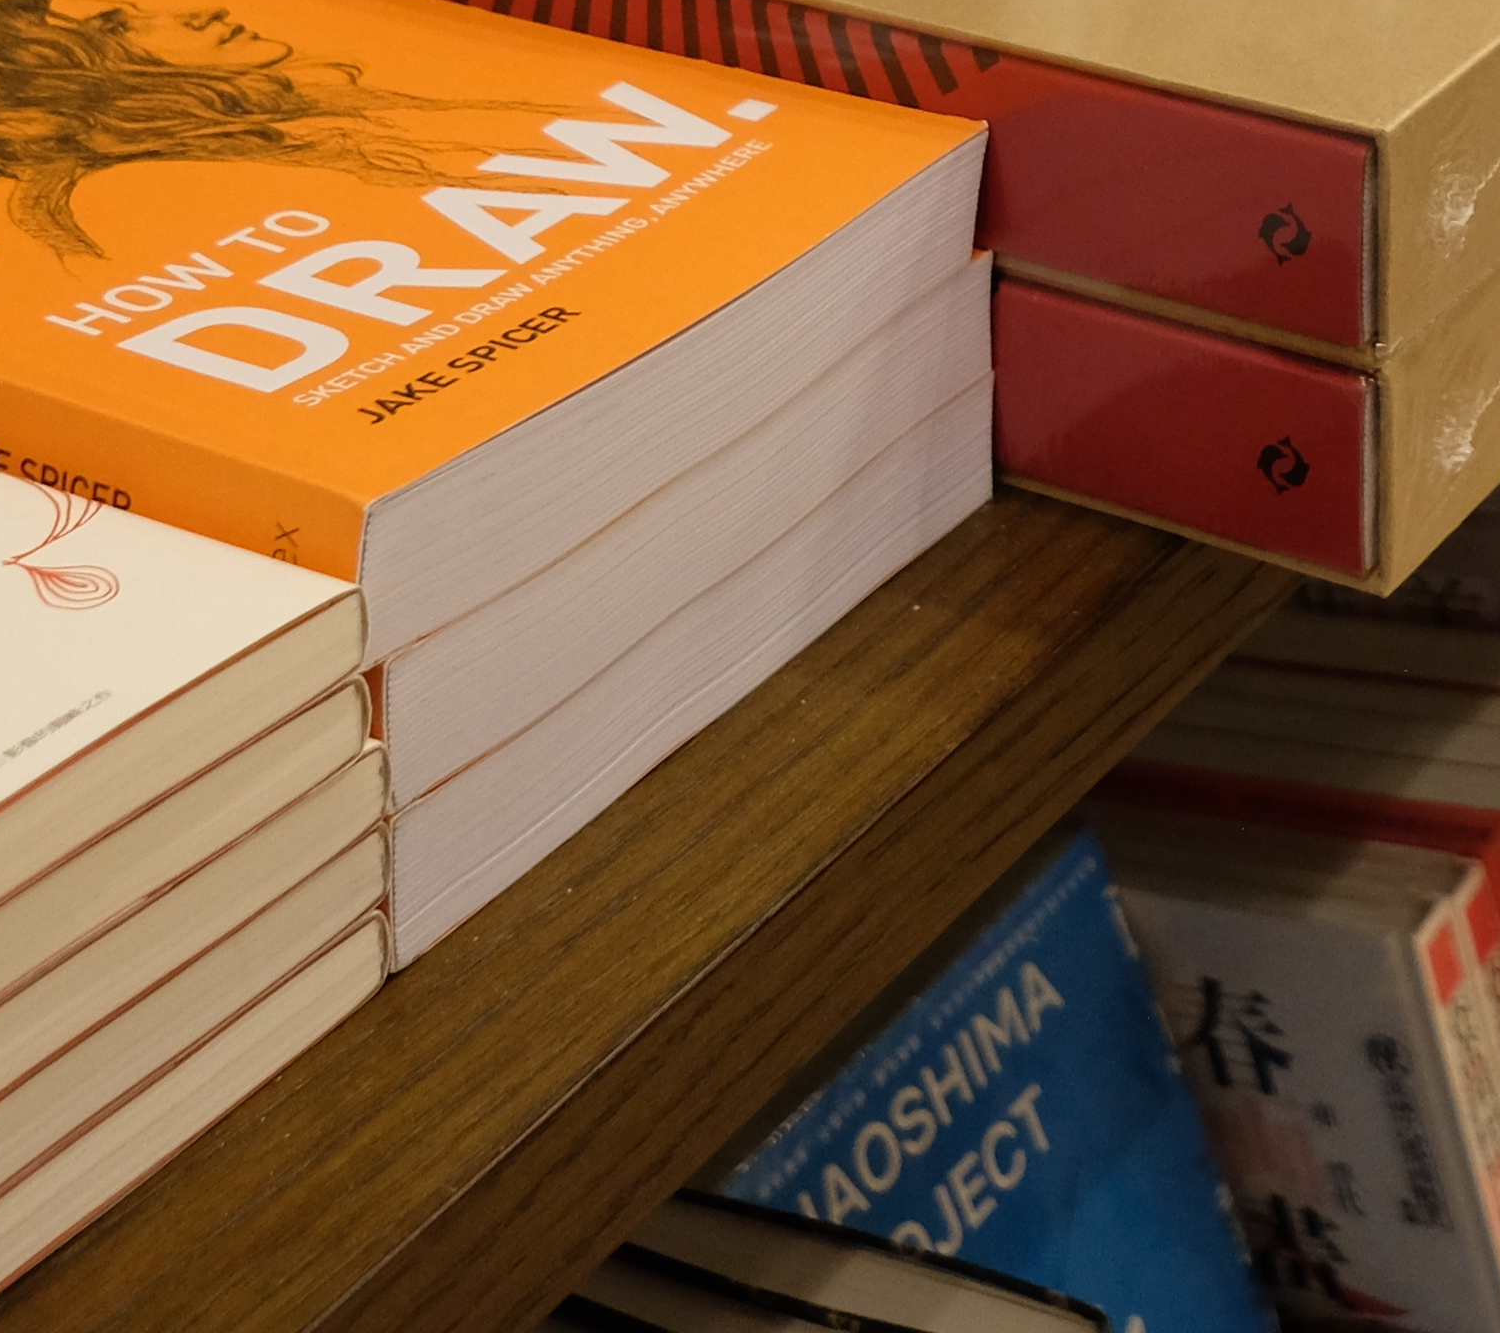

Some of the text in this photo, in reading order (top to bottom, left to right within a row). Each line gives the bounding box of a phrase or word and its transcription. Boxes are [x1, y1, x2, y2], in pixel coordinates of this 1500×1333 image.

[43, 207, 333, 338] HOW TO
[115, 79, 782, 396] DRAW.
[293, 136, 776, 410] SKETCH AND DRAW ANYTHING, ANYWHERE
[354, 304, 584, 428] JAKE SPICER
[888, 1084, 1058, 1260] OJECT
